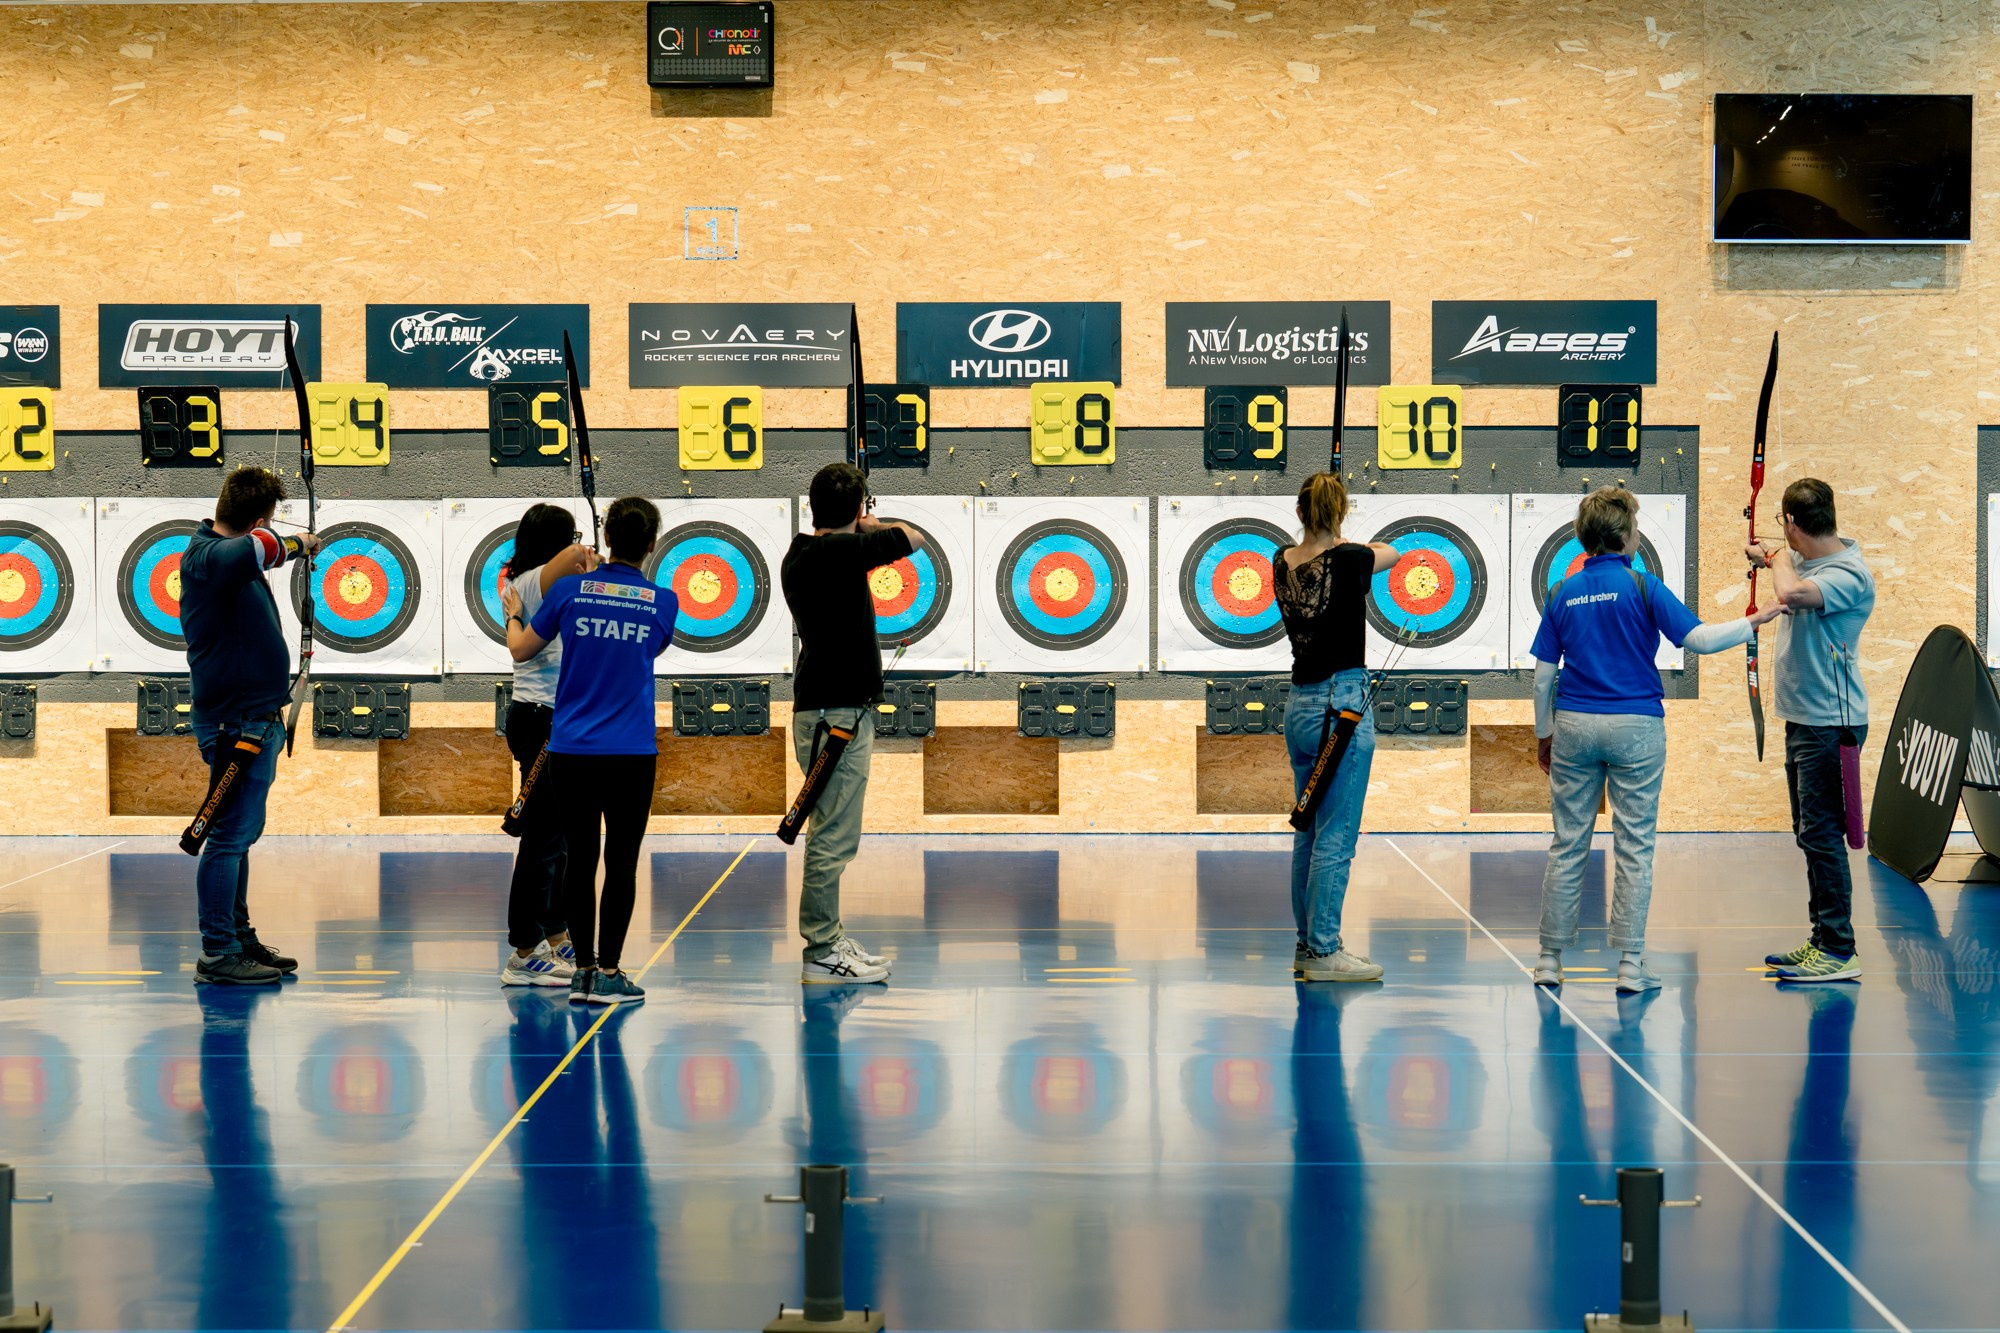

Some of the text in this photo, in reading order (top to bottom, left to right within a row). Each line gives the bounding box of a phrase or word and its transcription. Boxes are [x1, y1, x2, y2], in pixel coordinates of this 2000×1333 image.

[133, 328, 286, 353] HOYT
[142, 355, 272, 363] ARCHERY
[641, 323, 845, 342] NOVAERY
[644, 353, 840, 362] ROCKET SCIENCE FOR ARCHERY
[1189, 355, 1198, 365] A
[1311, 355, 1367, 365] LOGIICS
[1560, 353, 1626, 361] ARCHERY
[950, 359, 1068, 378] HYUNDAI
[14, 398, 46, 459] 2
[186, 395, 220, 457] 3
[350, 396, 383, 451] 4
[532, 392, 571, 455] 5
[723, 397, 756, 459] 6
[895, 393, 926, 452] 7
[1075, 393, 1111, 454] 8
[1247, 395, 1283, 459] 9
[1408, 396, 1457, 460] 10
[1587, 398, 1638, 452] 11
[574, 597, 657, 614] www.worldarchery.org
[1566, 592, 1618, 607] world archery
[575, 617, 651, 643] STAFF
[1306, 733, 1338, 794] EASTON
[1901, 718, 1959, 806] YOUYI
[201, 762, 239, 820] EASTON
